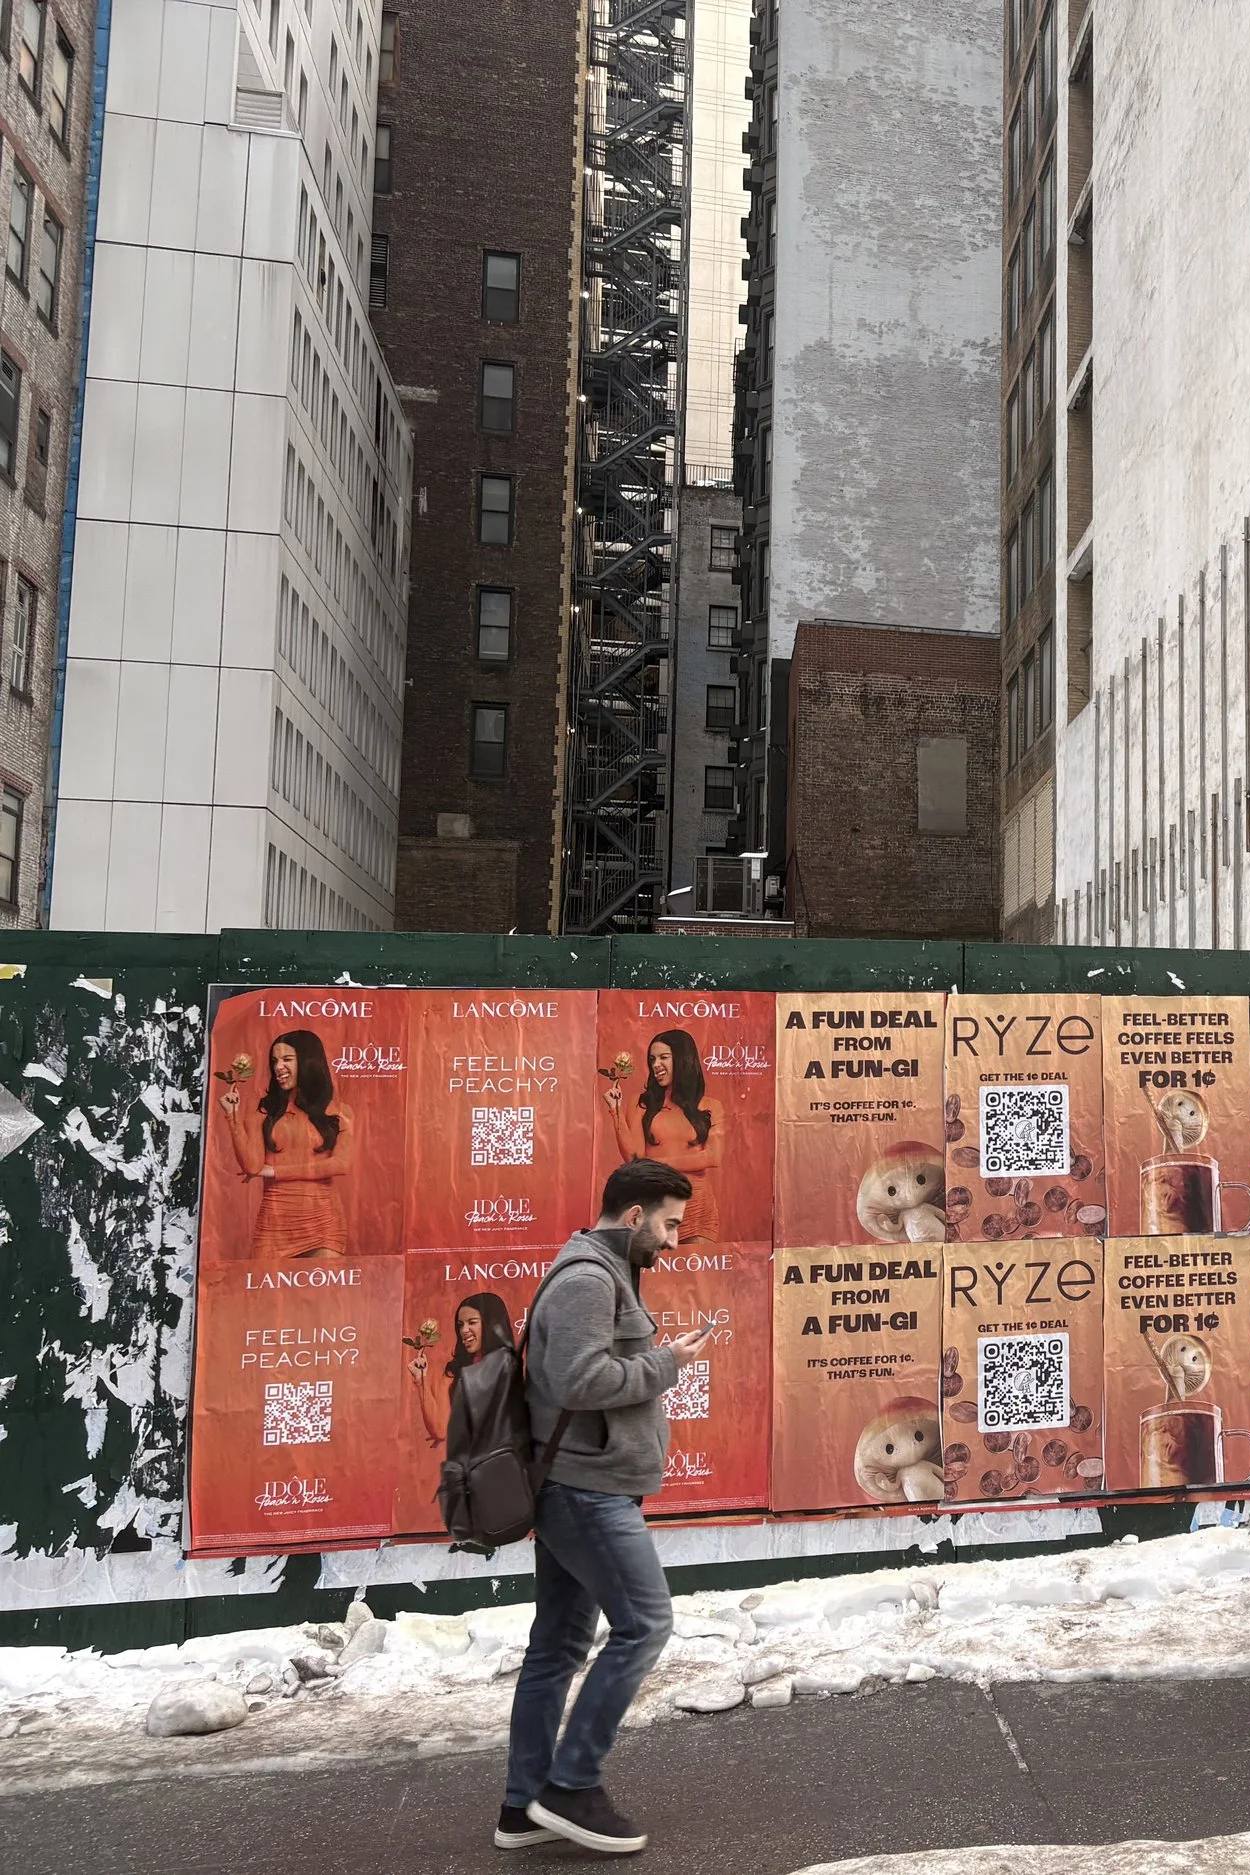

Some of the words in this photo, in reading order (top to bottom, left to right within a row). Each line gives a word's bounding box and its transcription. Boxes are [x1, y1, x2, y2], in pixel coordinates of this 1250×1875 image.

[259, 998, 373, 1018] LANCÔME
[452, 998, 559, 1018] LANCÔME
[639, 999, 740, 1018] LANCÔME
[785, 1011, 806, 1029] A
[812, 1011, 864, 1029] FUN
[870, 1010, 937, 1028] DEAL
[1122, 1013, 1229, 1026] FEEL-BETTER
[834, 1036, 891, 1051] FROM
[1117, 1032, 1182, 1045] COFFEE
[1186, 1032, 1235, 1045] FEELS
[342, 1042, 400, 1062] IDÔLE
[1120, 1051, 1166, 1064] EVEN
[1171, 1051, 1233, 1064] BETTER
[453, 1056, 555, 1072] FEELING
[804, 1060, 825, 1079] A
[831, 1059, 919, 1079] FUN-GI
[449, 1077, 558, 1093] PEACHY?
[979, 1073, 1002, 1082] GET
[1003, 1073, 1025, 1081] THE
[1040, 1072, 1069, 1081] DEAL
[1139, 1070, 1187, 1088] FOR
[1192, 1069, 1216, 1088] 1¢
[810, 1102, 830, 1111] IT'S
[833, 1101, 874, 1110] COFFEE
[876, 1100, 899, 1109] FOR
[830, 1113, 869, 1123] THAT'S
[871, 1113, 897, 1122] FUN.
[474, 1194, 530, 1214] IDÔLE
[642, 1253, 733, 1273] NCÔME
[1124, 1252, 1232, 1269] FEEL-BETTER
[245, 1267, 361, 1289] LANCÔME
[783, 1265, 804, 1284] A
[810, 1263, 862, 1284] FUN
[868, 1259, 937, 1281] DEAL
[1118, 1274, 1185, 1289] COFFEE
[1188, 1271, 1238, 1287] FEELS
[831, 1288, 890, 1306] FROM
[1120, 1294, 1168, 1310] EVEN
[1173, 1291, 1236, 1307] BETTER
[650, 1308, 730, 1327] ELING
[801, 1316, 823, 1336] A
[828, 1311, 918, 1334] FUN-GI
[977, 1323, 1000, 1333] GET
[1002, 1322, 1023, 1332] THE
[1040, 1319, 1069, 1329] DEAL
[1139, 1314, 1189, 1334] FOR
[1194, 1311, 1220, 1331] 1¢
[246, 1326, 357, 1346] FEELING
[241, 1348, 359, 1369] PEACHY?
[807, 1358, 828, 1368] IT'S
[830, 1356, 872, 1367] COFFEE
[874, 1354, 897, 1365] FOR
[827, 1369, 867, 1380] THAT'S
[869, 1367, 895, 1377] FUN.
[664, 1449, 707, 1469] ÔLE
[264, 1475, 326, 1497] IDÔLE
